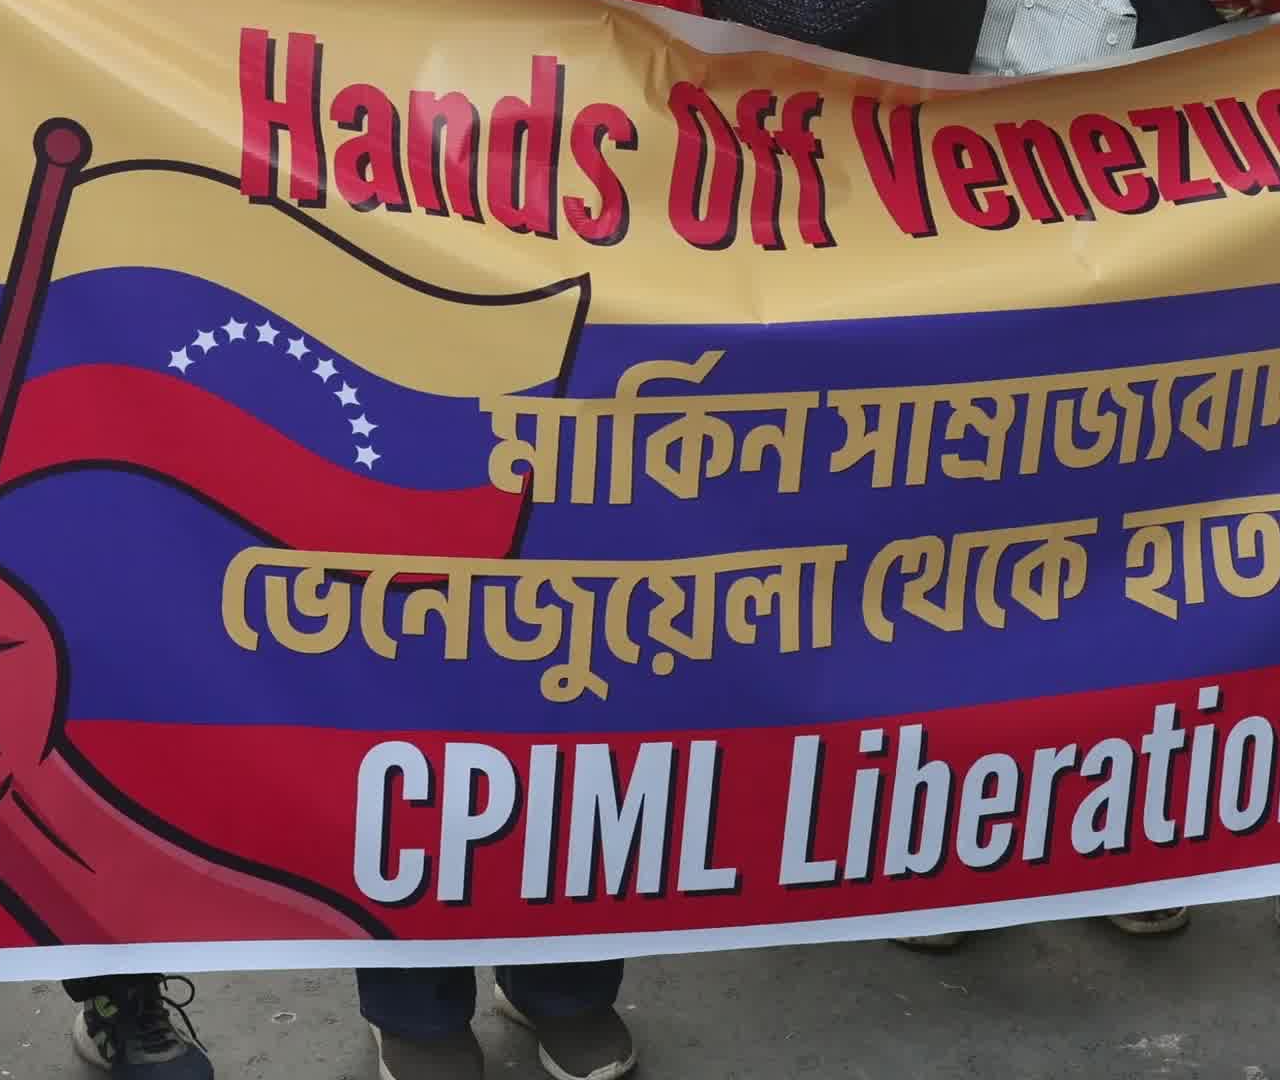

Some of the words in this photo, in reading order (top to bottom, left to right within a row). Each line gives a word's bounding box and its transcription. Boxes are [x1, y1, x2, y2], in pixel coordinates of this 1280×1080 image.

[239, 27, 638, 247] Hands
[667, 80, 836, 251] Off
[479, 350, 820, 505] মার্কিন
[221, 544, 848, 703] ভেনেজুয়েলা
[862, 517, 1099, 643] থেকে
[352, 738, 741, 908] CPIML
